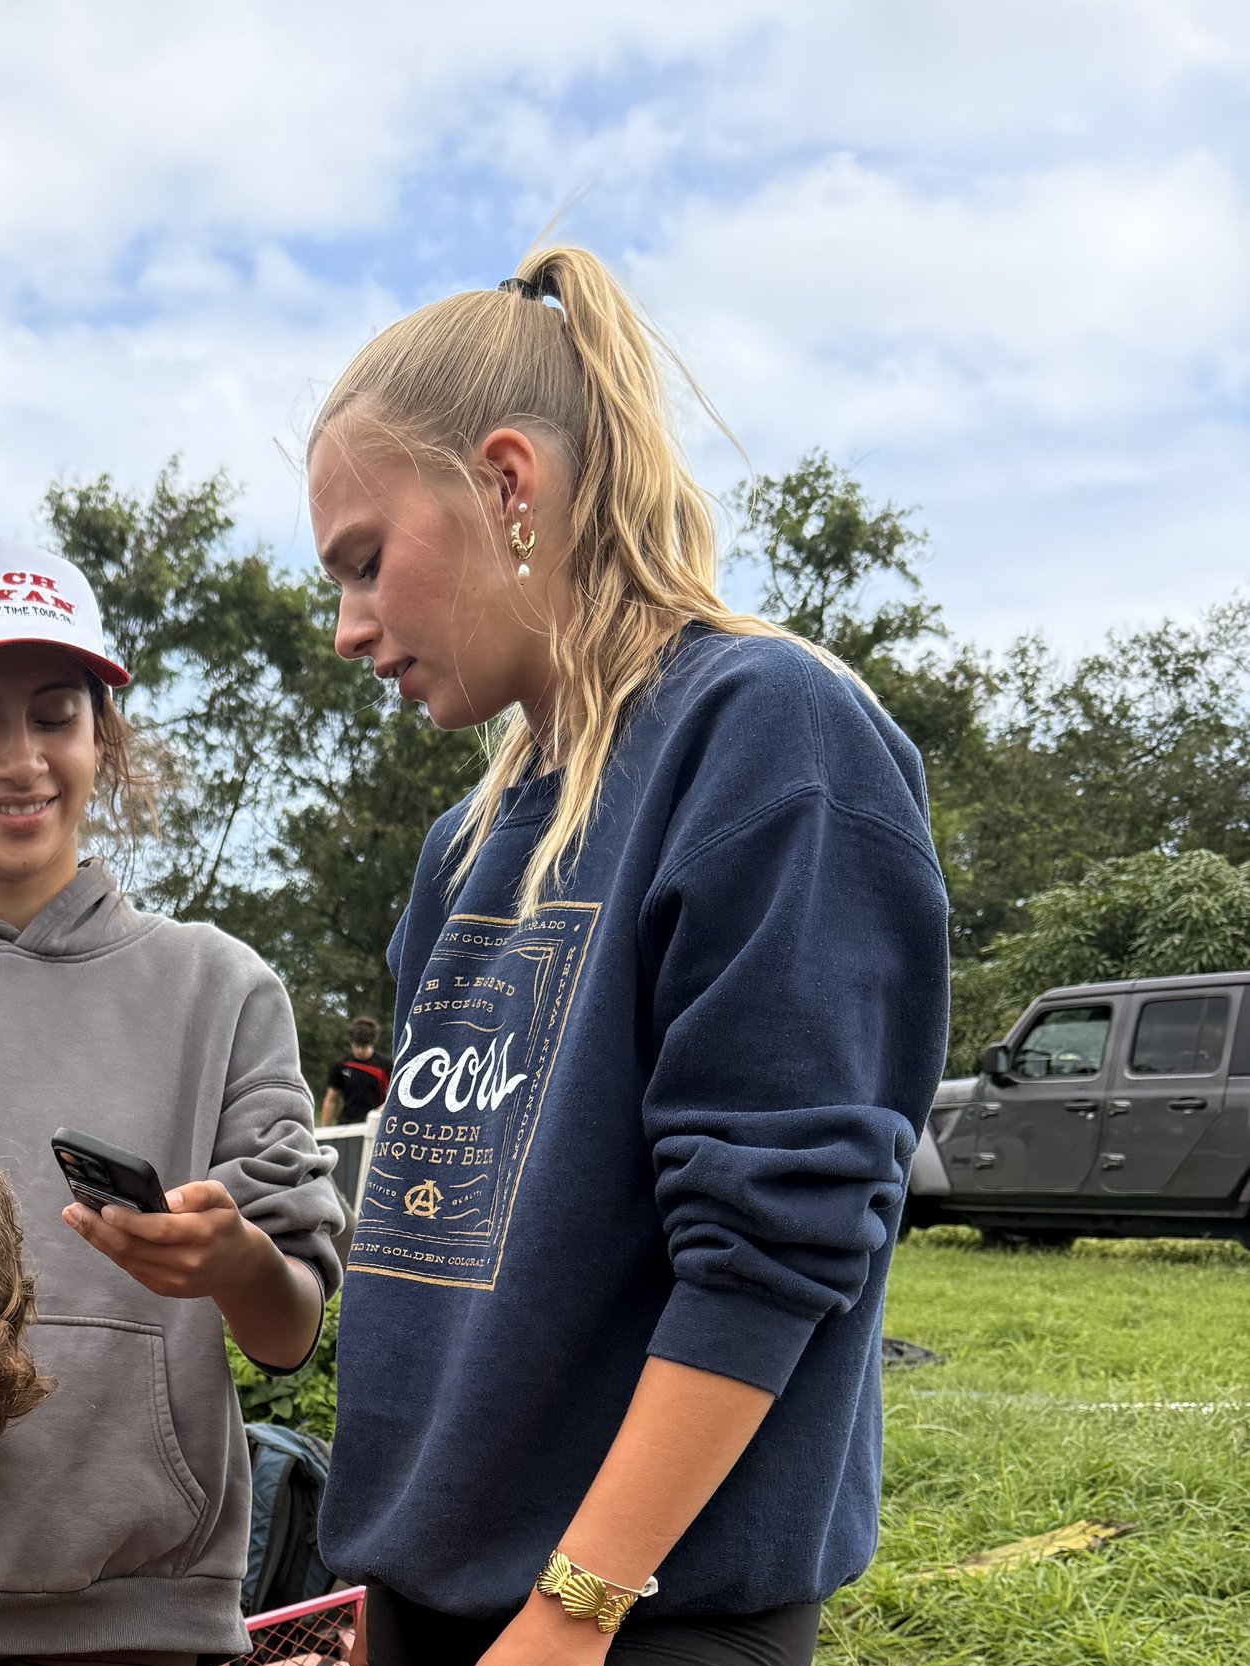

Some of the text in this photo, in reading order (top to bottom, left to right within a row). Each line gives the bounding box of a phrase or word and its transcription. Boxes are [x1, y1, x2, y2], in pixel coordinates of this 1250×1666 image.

[4, 606, 31, 616] TIME
[462, 933, 509, 948] GOLD
[413, 999, 470, 1015] SINCE
[385, 1115, 482, 1142] GOLDEN
[373, 1141, 458, 1166] NQUET
[382, 1246, 445, 1264] GOLDEN
[448, 1255, 486, 1267] COLORA
